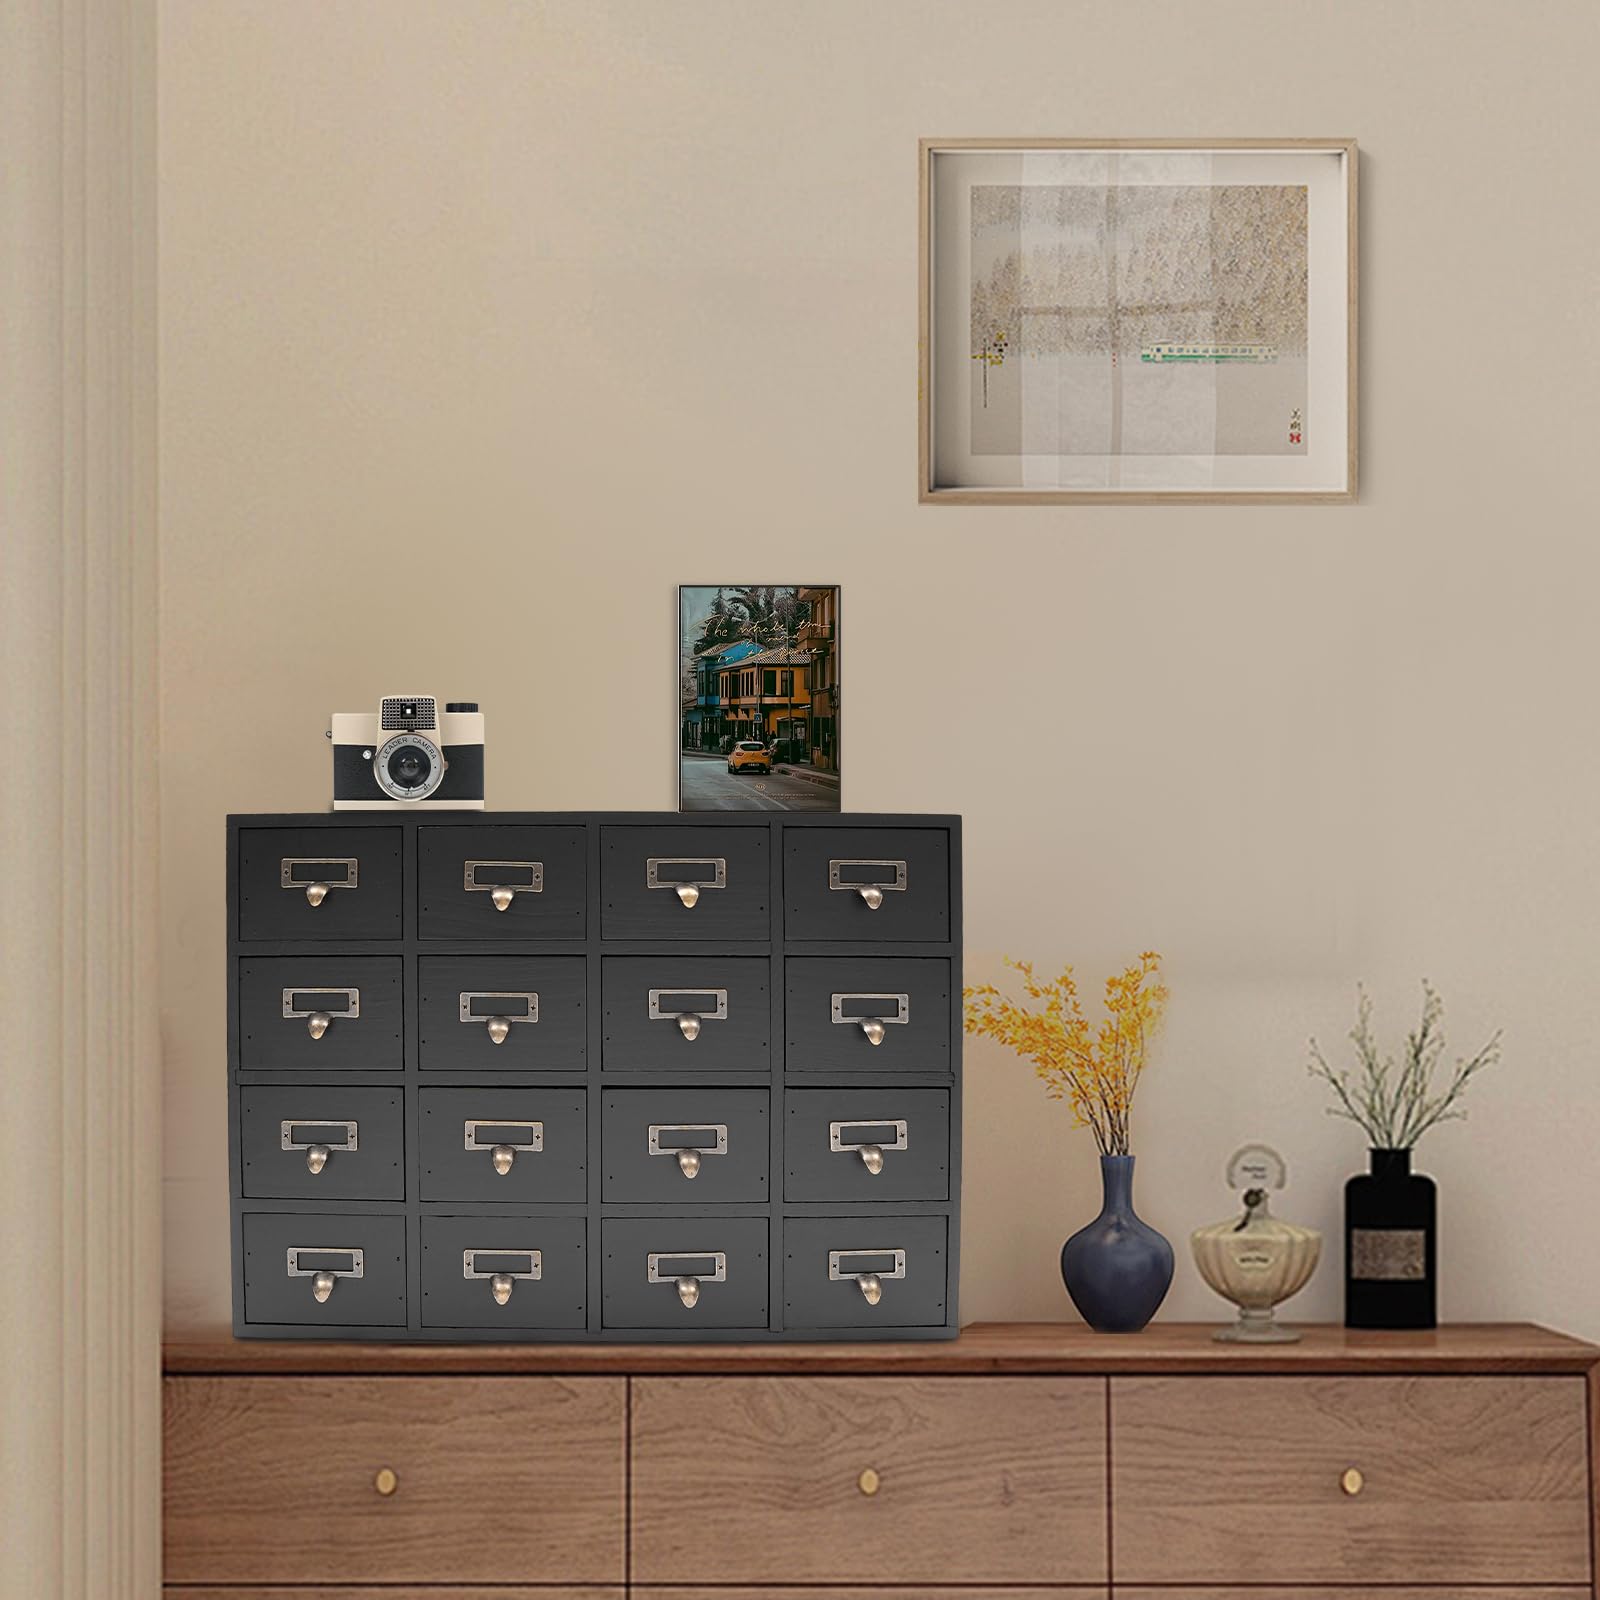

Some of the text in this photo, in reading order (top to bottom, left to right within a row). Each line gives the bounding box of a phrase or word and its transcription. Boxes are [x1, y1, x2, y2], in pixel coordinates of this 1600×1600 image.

[689, 614, 728, 637] The
[382, 737, 437, 760] LEADER CAMERA
